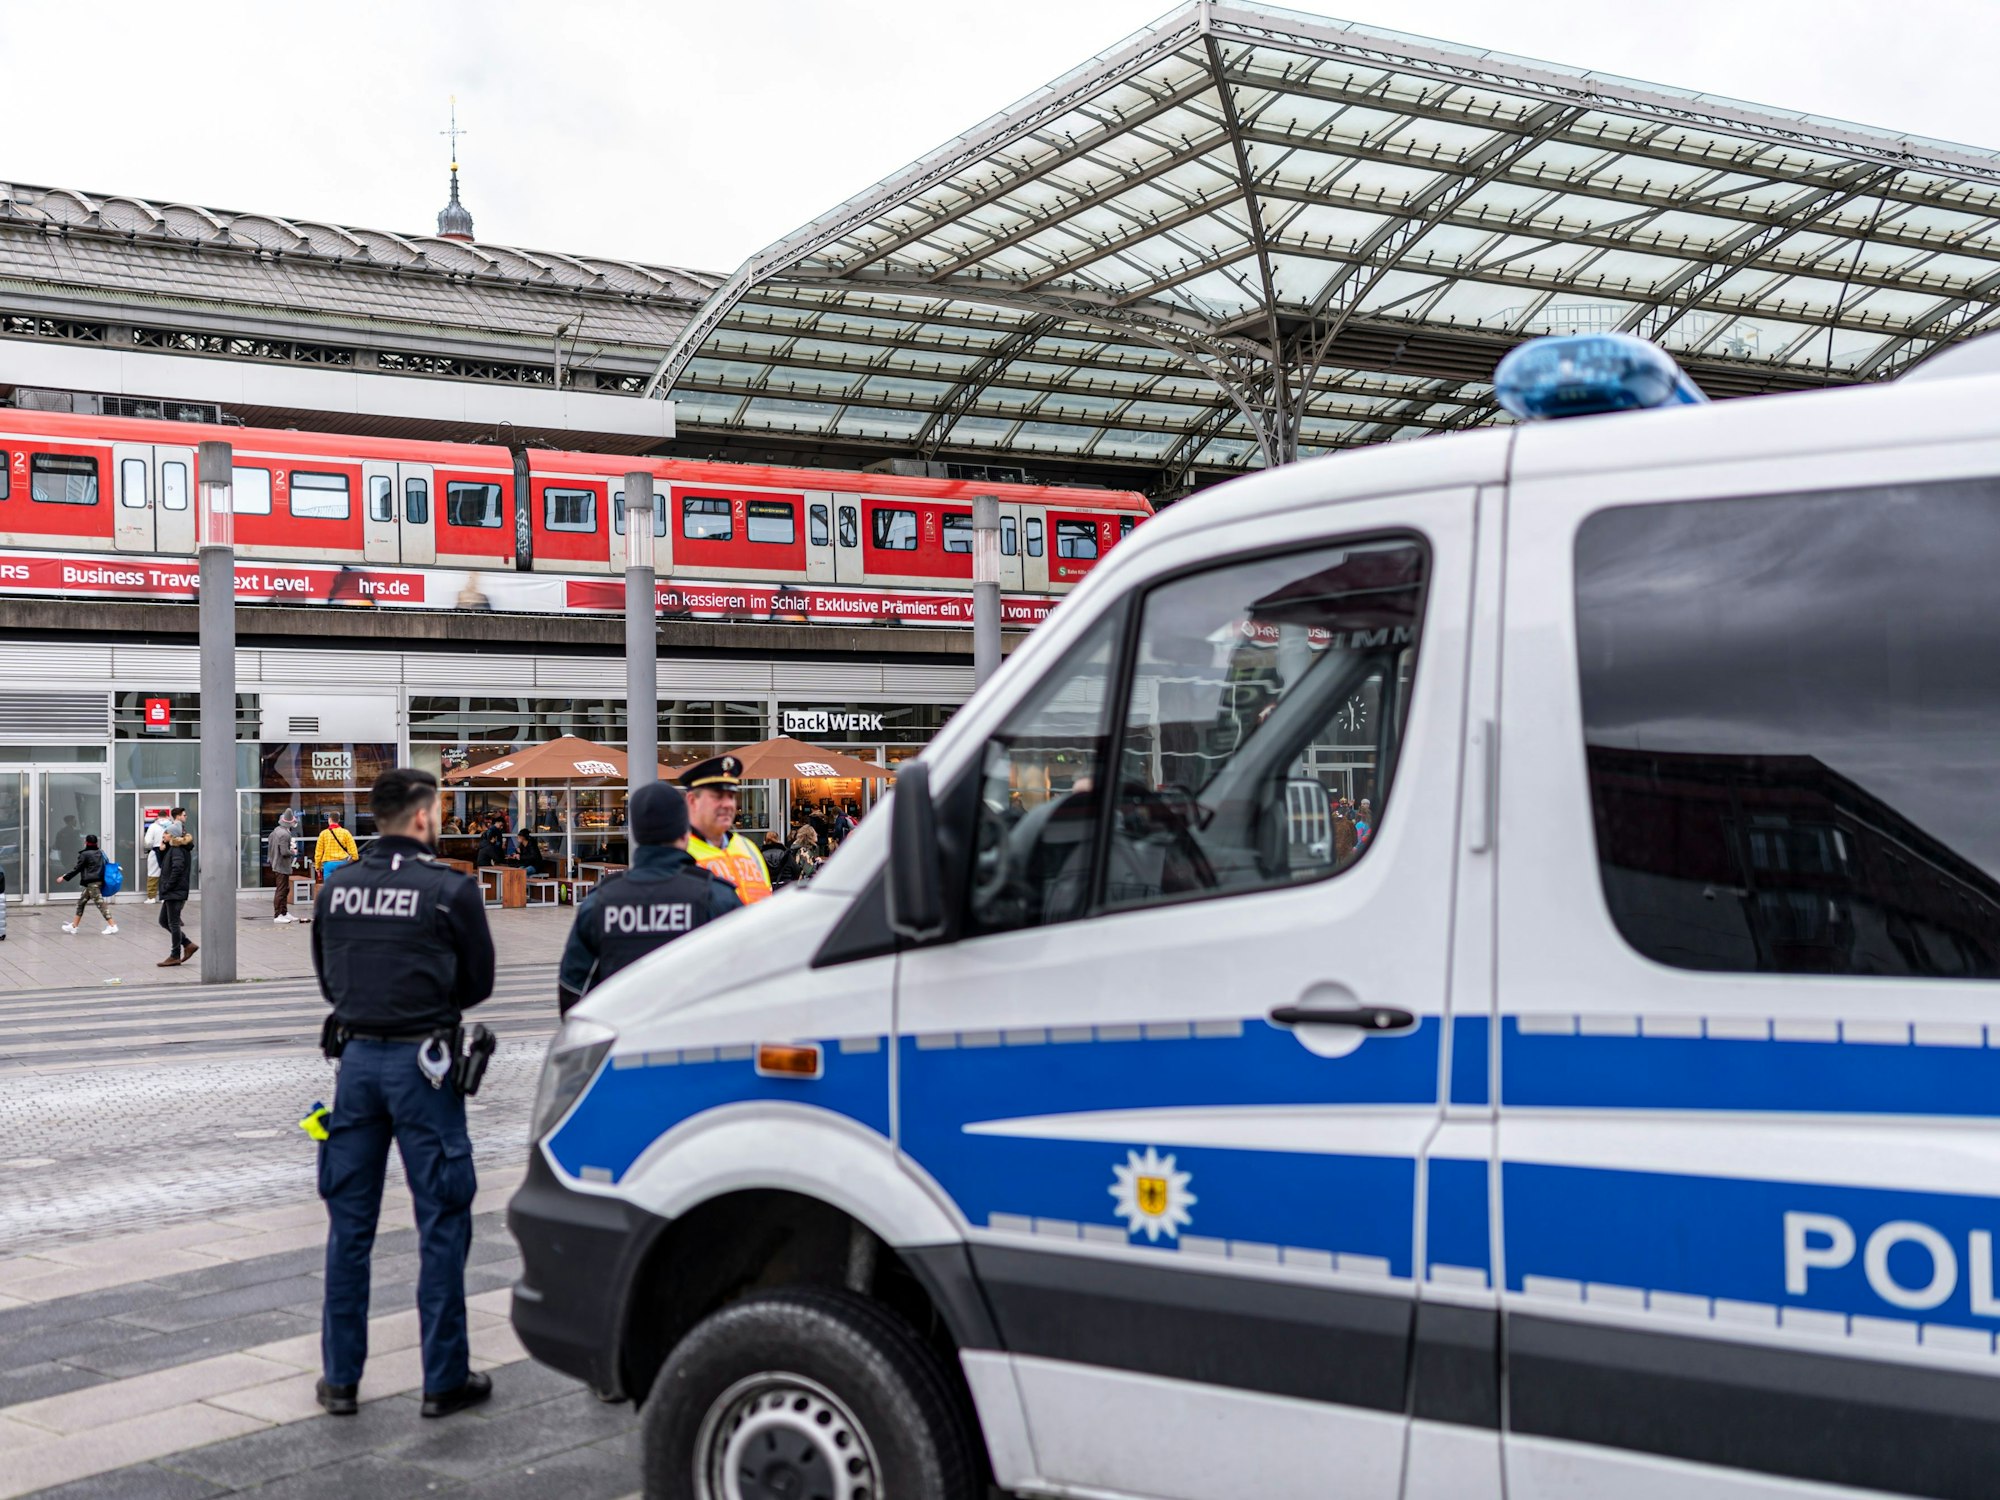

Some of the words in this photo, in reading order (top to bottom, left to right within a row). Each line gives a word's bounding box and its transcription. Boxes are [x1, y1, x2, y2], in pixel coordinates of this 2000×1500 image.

[14, 451, 25, 467] 2
[275, 470, 285, 485] 2
[735, 500, 743, 513] 2
[925, 512, 933, 525] 2
[1103, 523, 1110, 535] 2
[0, 564, 30, 580] RS
[63, 566, 145, 586] Business
[149, 570, 200, 588] Trave
[234, 574, 259, 590] ext
[263, 575, 315, 593] Level.
[358, 578, 410, 596] hrs.de
[654, 590, 678, 606] ilen
[682, 592, 746, 608] kassieren
[750, 594, 767, 609] im
[770, 595, 812, 611] Schlaf.
[816, 597, 879, 613] Exklusive
[881, 600, 938, 615] Prämien:
[940, 602, 960, 616] ein
[1007, 606, 1031, 619] von
[314, 753, 350, 767] back
[311, 769, 352, 780] WERK
[329, 886, 419, 917] POLIZEI
[604, 903, 692, 933] POLIZEI
[1783, 1210, 2000, 1318] POL
